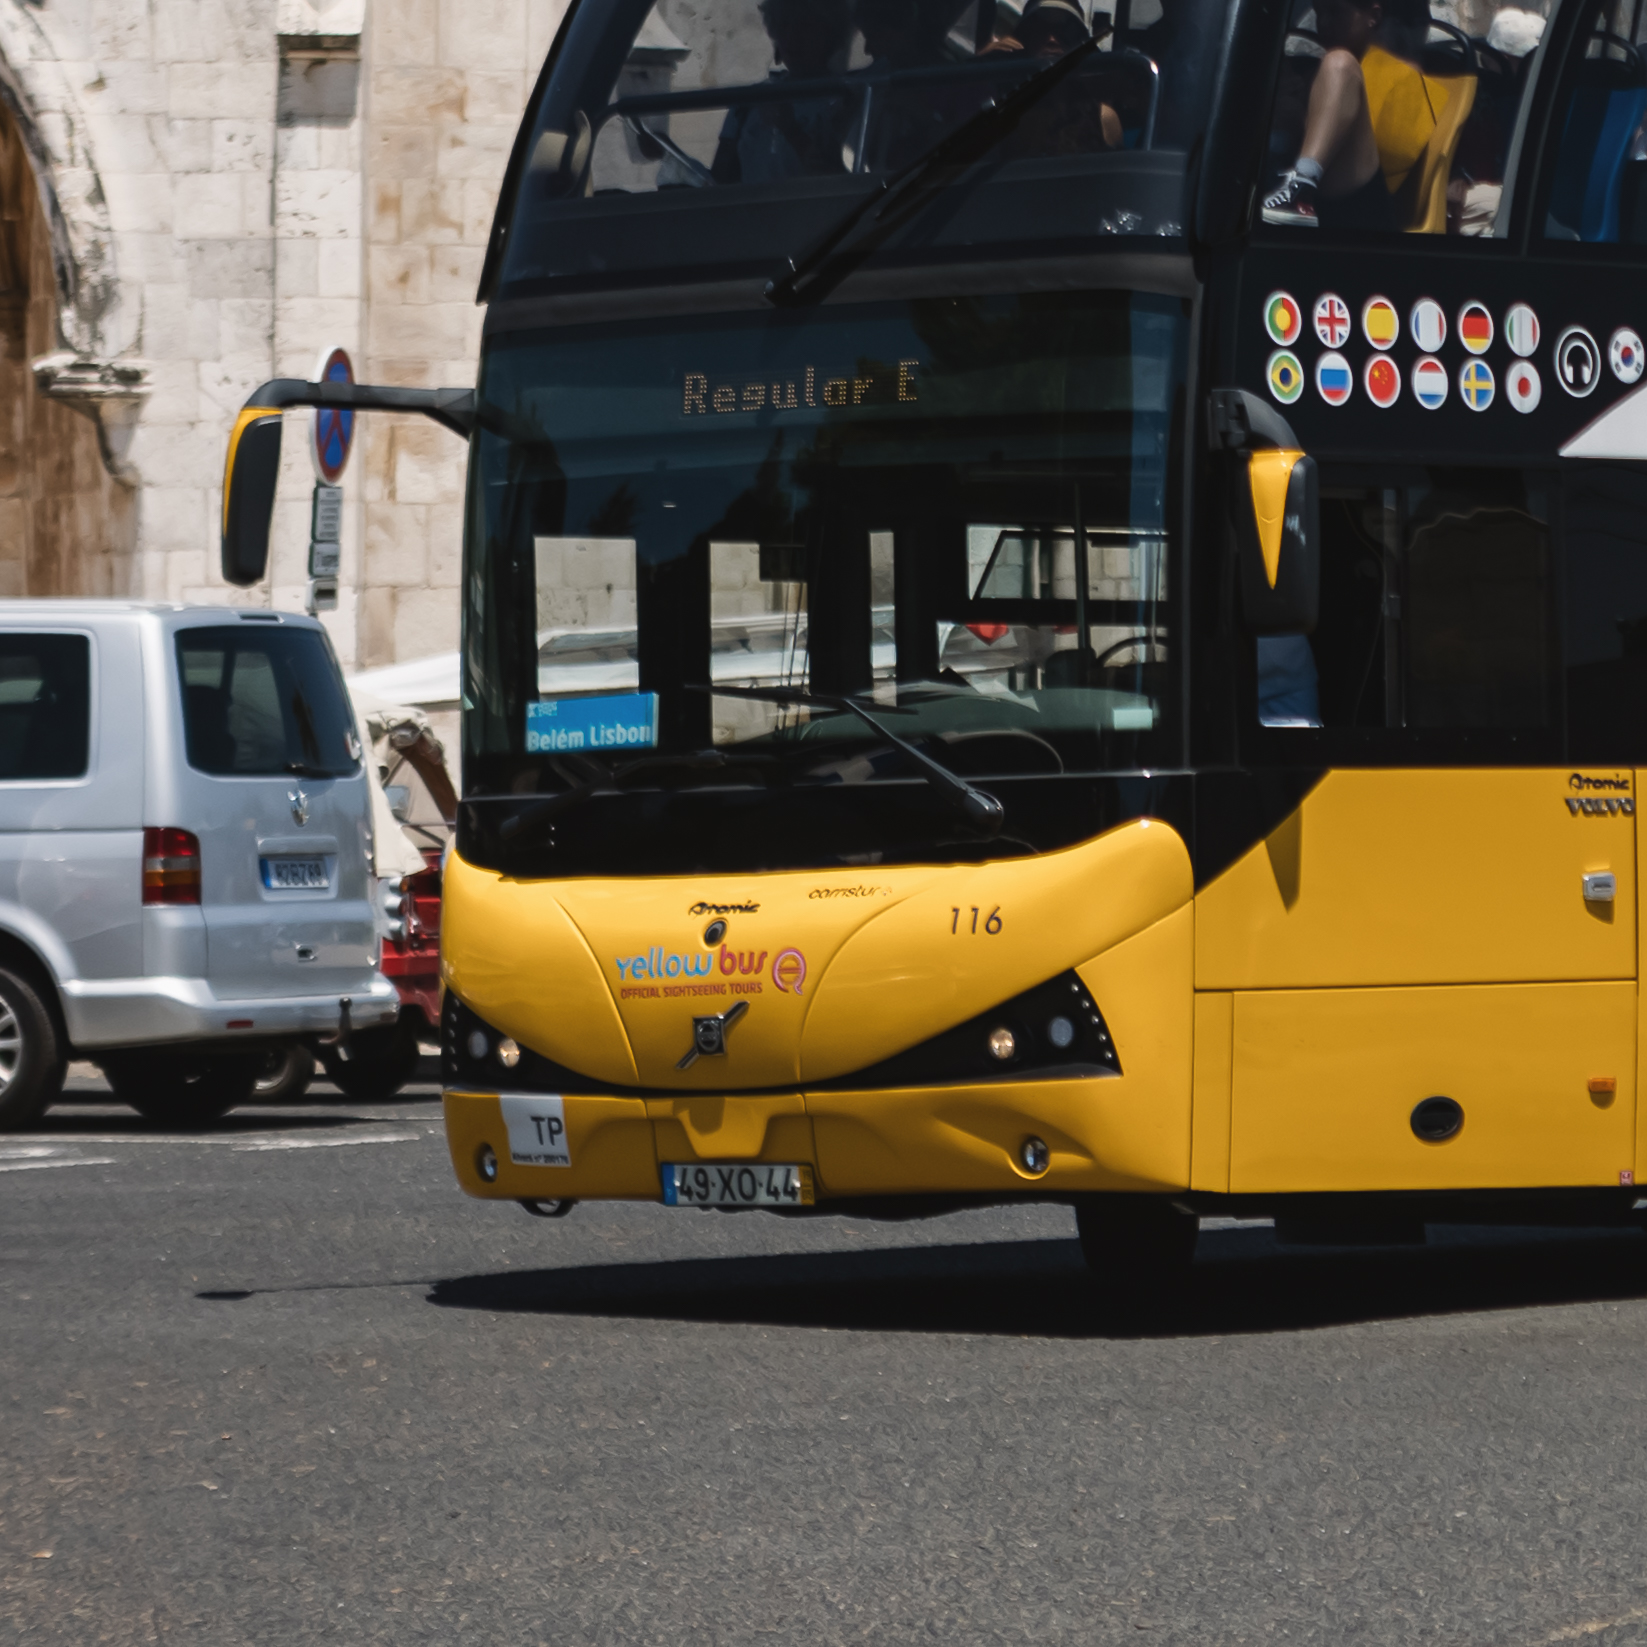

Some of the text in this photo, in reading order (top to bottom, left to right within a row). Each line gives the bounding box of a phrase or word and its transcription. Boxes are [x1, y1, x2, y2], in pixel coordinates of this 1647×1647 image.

[528, 727, 585, 752] Belém
[1564, 797, 1635, 816] VOLVO
[951, 906, 1003, 935] 116
[616, 946, 714, 981] yellow
[719, 944, 768, 976] bus
[621, 982, 763, 1000] OFFICIAL SIGHTSEEING TOURS
[530, 1115, 564, 1146] TP
